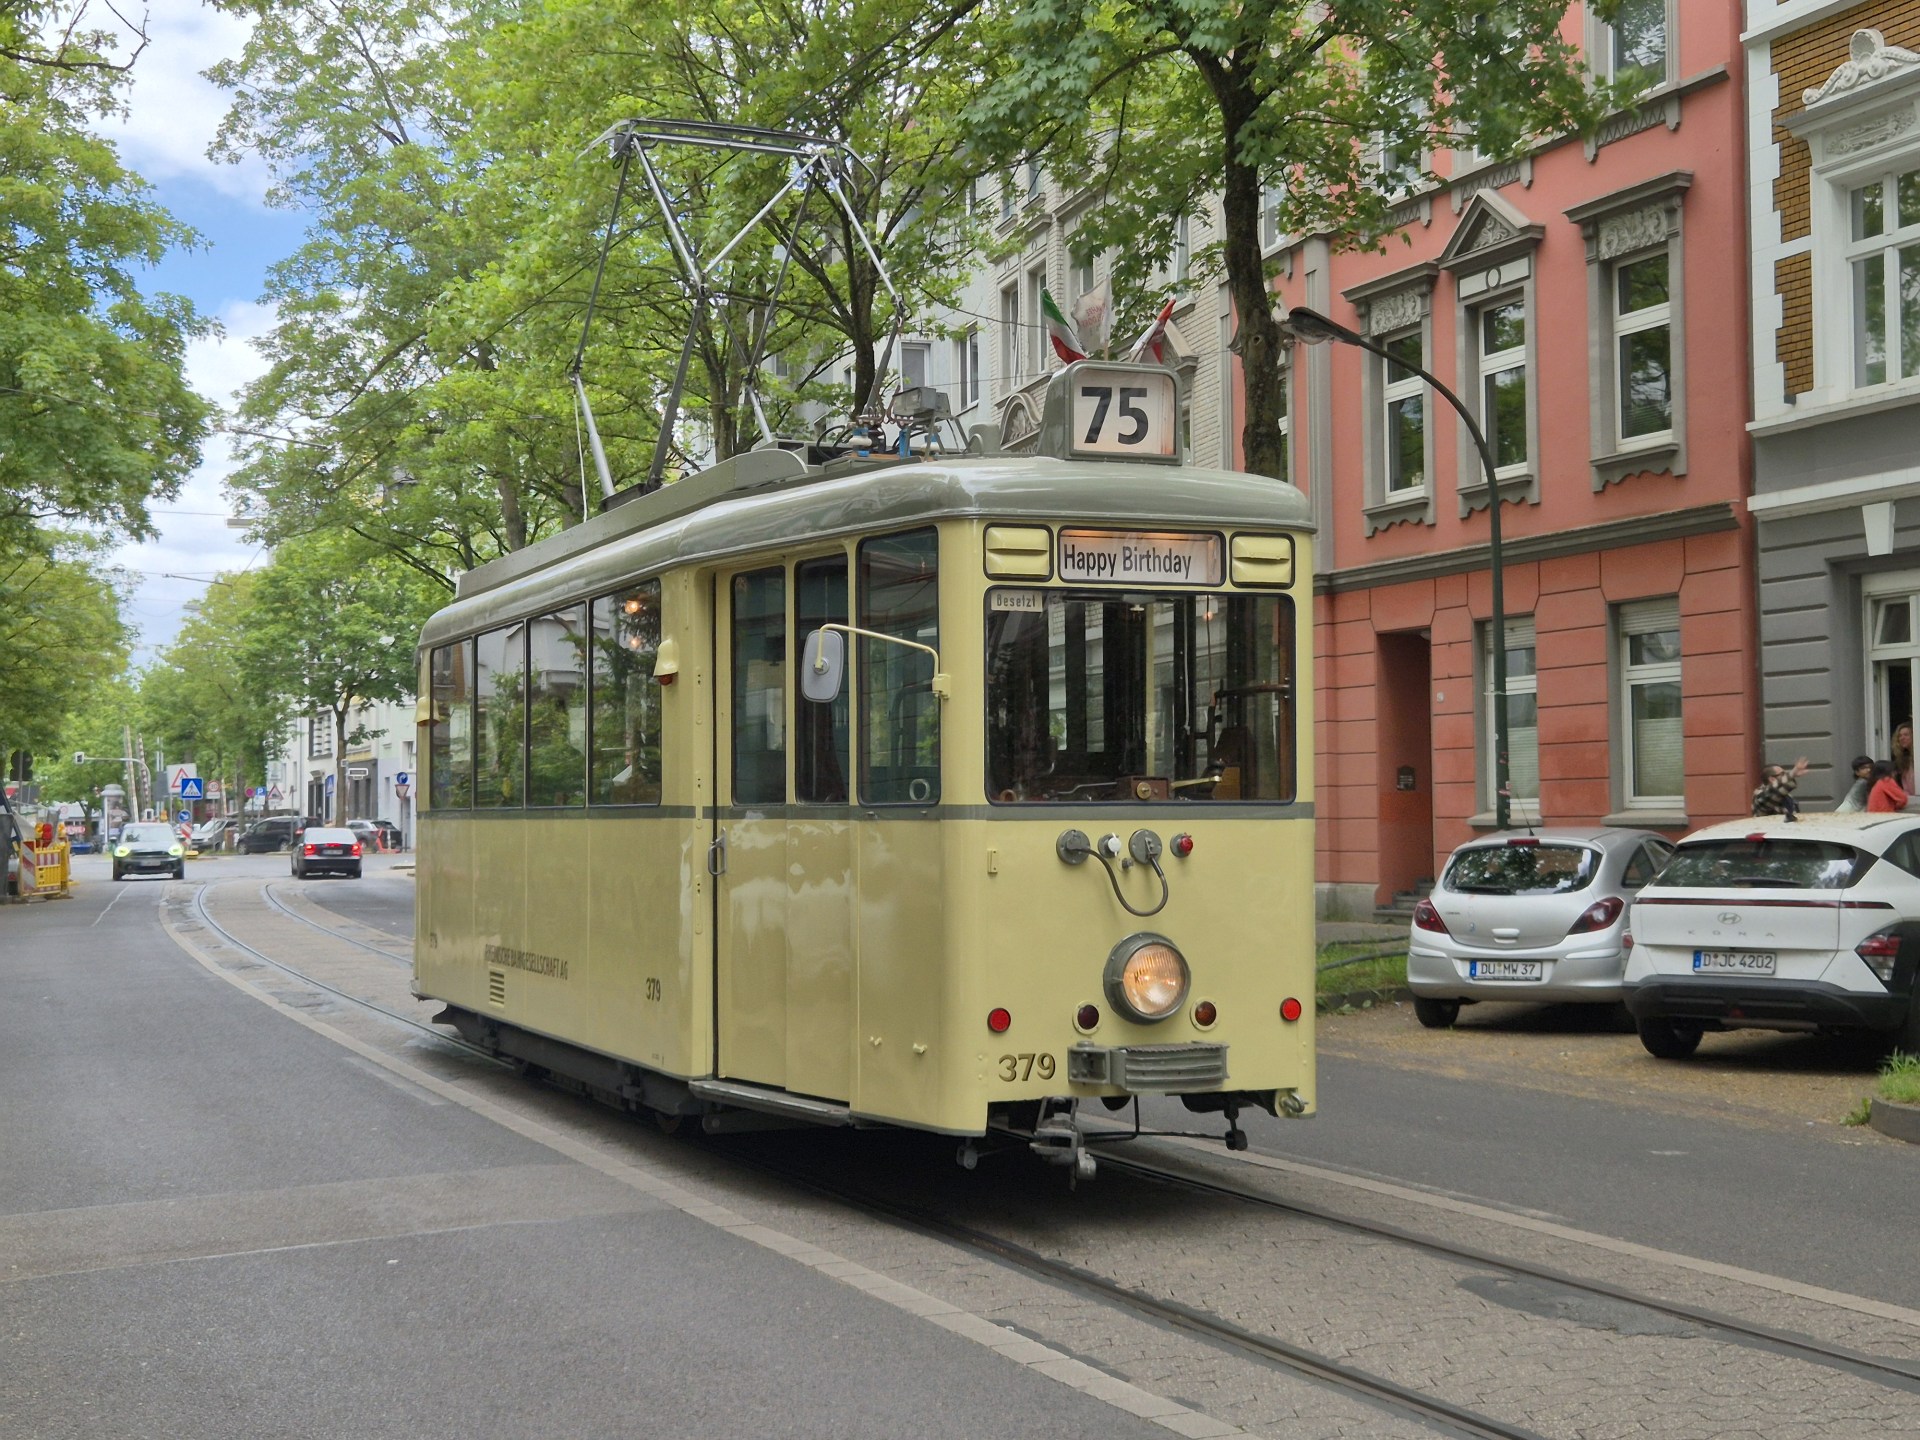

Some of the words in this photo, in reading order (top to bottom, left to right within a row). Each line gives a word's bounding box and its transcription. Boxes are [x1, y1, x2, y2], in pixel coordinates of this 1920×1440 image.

[1081, 387, 1149, 445] 75
[1063, 544, 1117, 577] Happy
[1122, 546, 1192, 580] Birthday
[996, 593, 1036, 608] Besetzt
[1481, 964, 1496, 975] DU
[1503, 964, 1519, 975] MW
[1522, 964, 1536, 975] 37
[1703, 954, 1711, 967] D
[1719, 954, 1736, 968] JC
[1739, 955, 1773, 969] 4202
[645, 977, 661, 1002] 379
[998, 1052, 1056, 1082] 379
